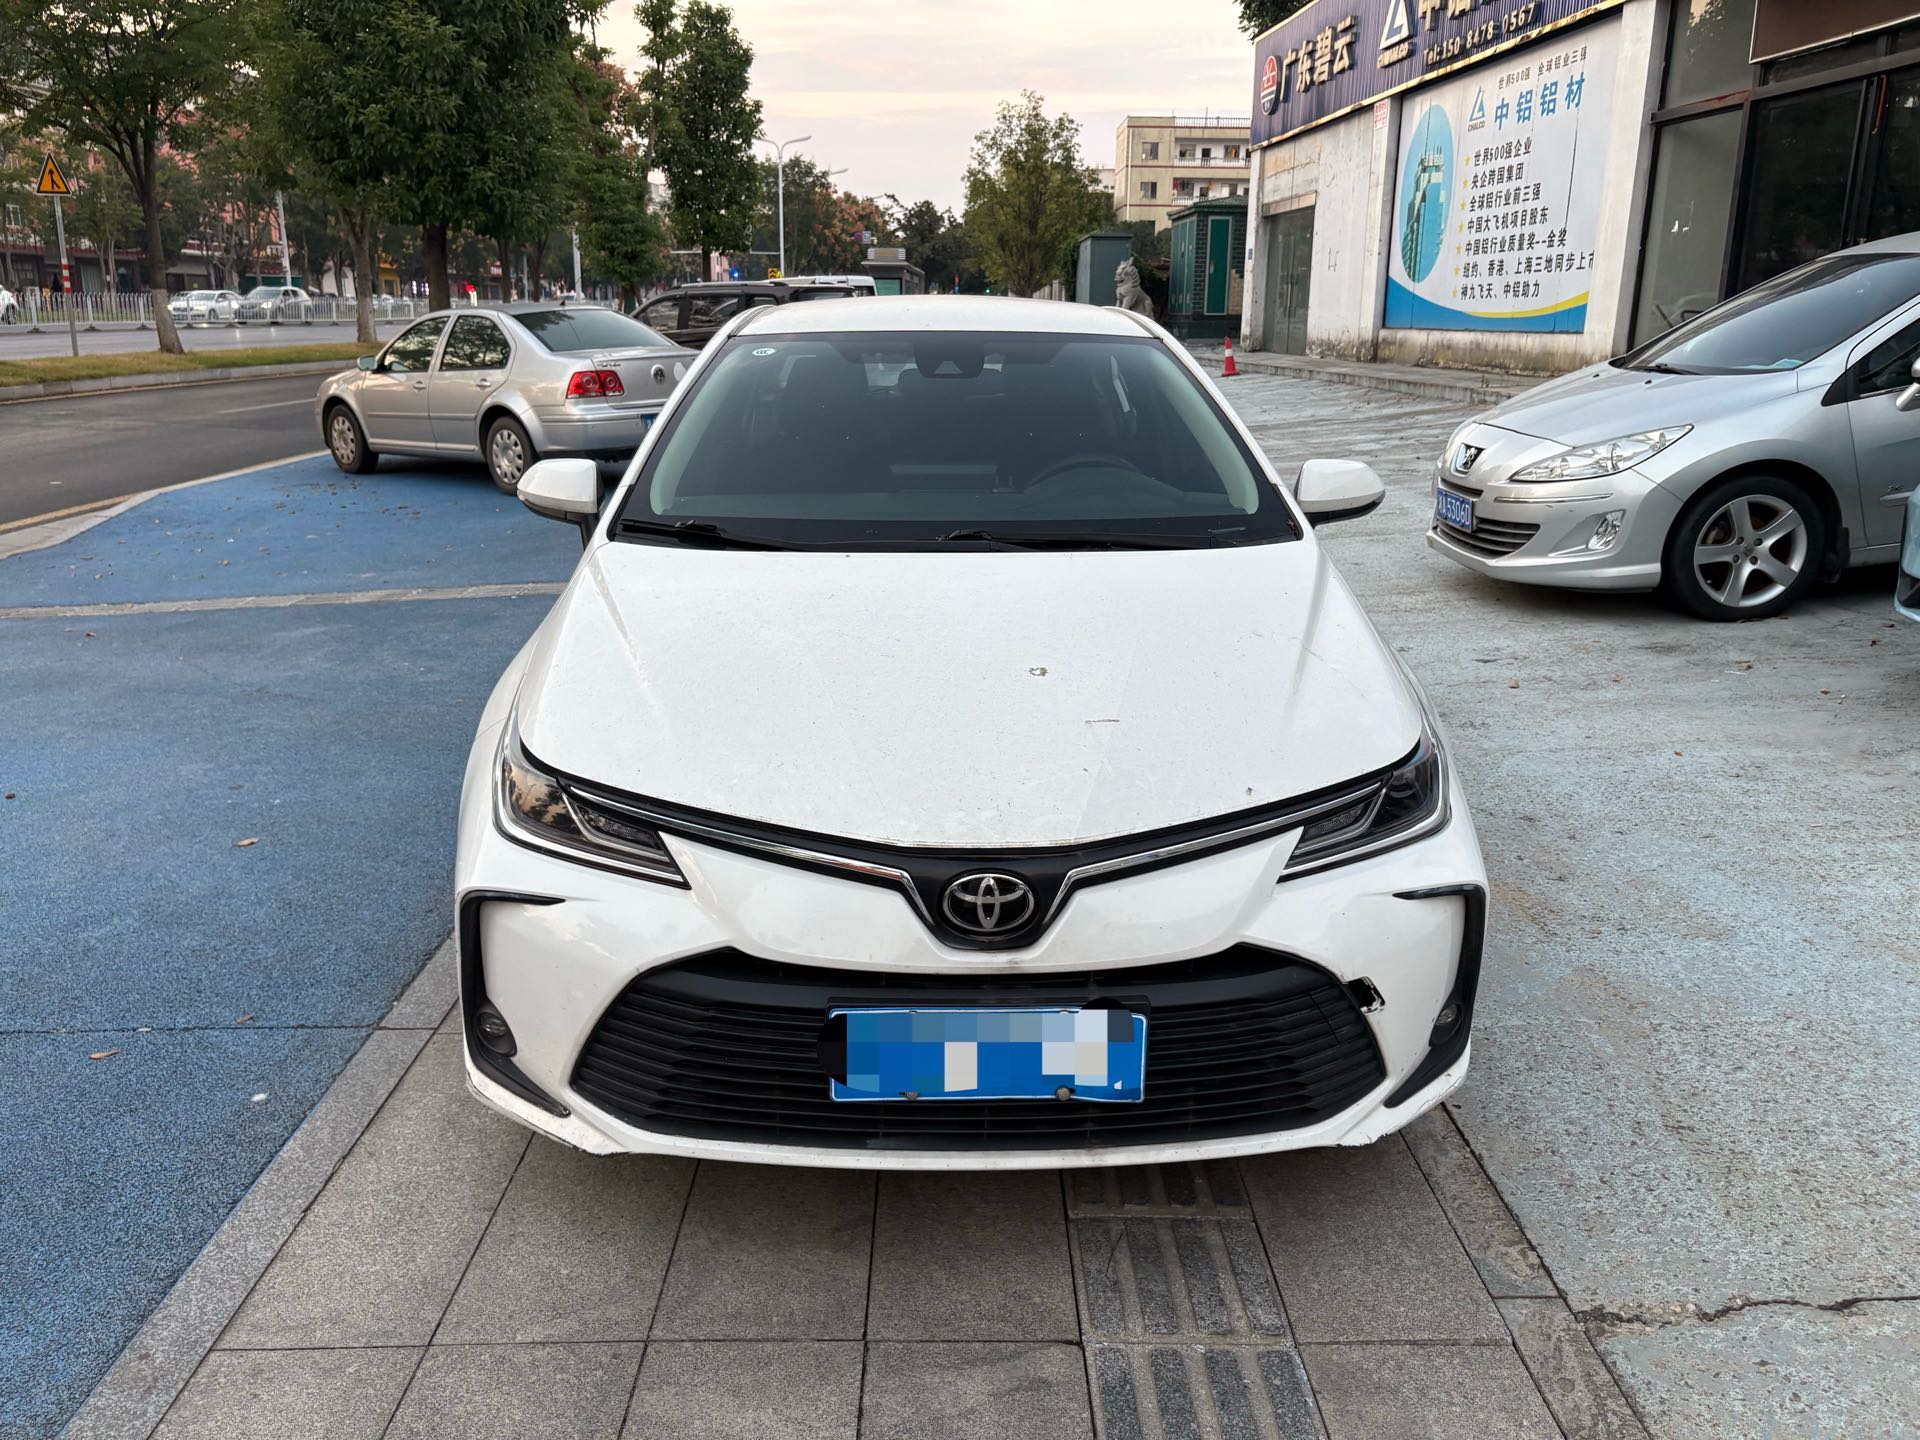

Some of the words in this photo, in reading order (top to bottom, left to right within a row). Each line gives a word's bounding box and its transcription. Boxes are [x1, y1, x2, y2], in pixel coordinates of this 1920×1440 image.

[1466, 21, 1494, 49] 8478
[1280, 16, 1355, 102] 广东碧云
[1537, 45, 1588, 76] 全球铝业三强
[1494, 71, 1585, 131] 中铝铝材
[1467, 120, 1486, 132] CHALCO
[1473, 136, 1532, 167] 世界500强企业
[1471, 162, 1524, 190] 央企跨国集团
[1469, 182, 1541, 212] 全球铝行业前三强
[1467, 205, 1549, 235] 中国大飞机项目股东
[1461, 280, 1540, 300] 神九飞天、中铝助力
